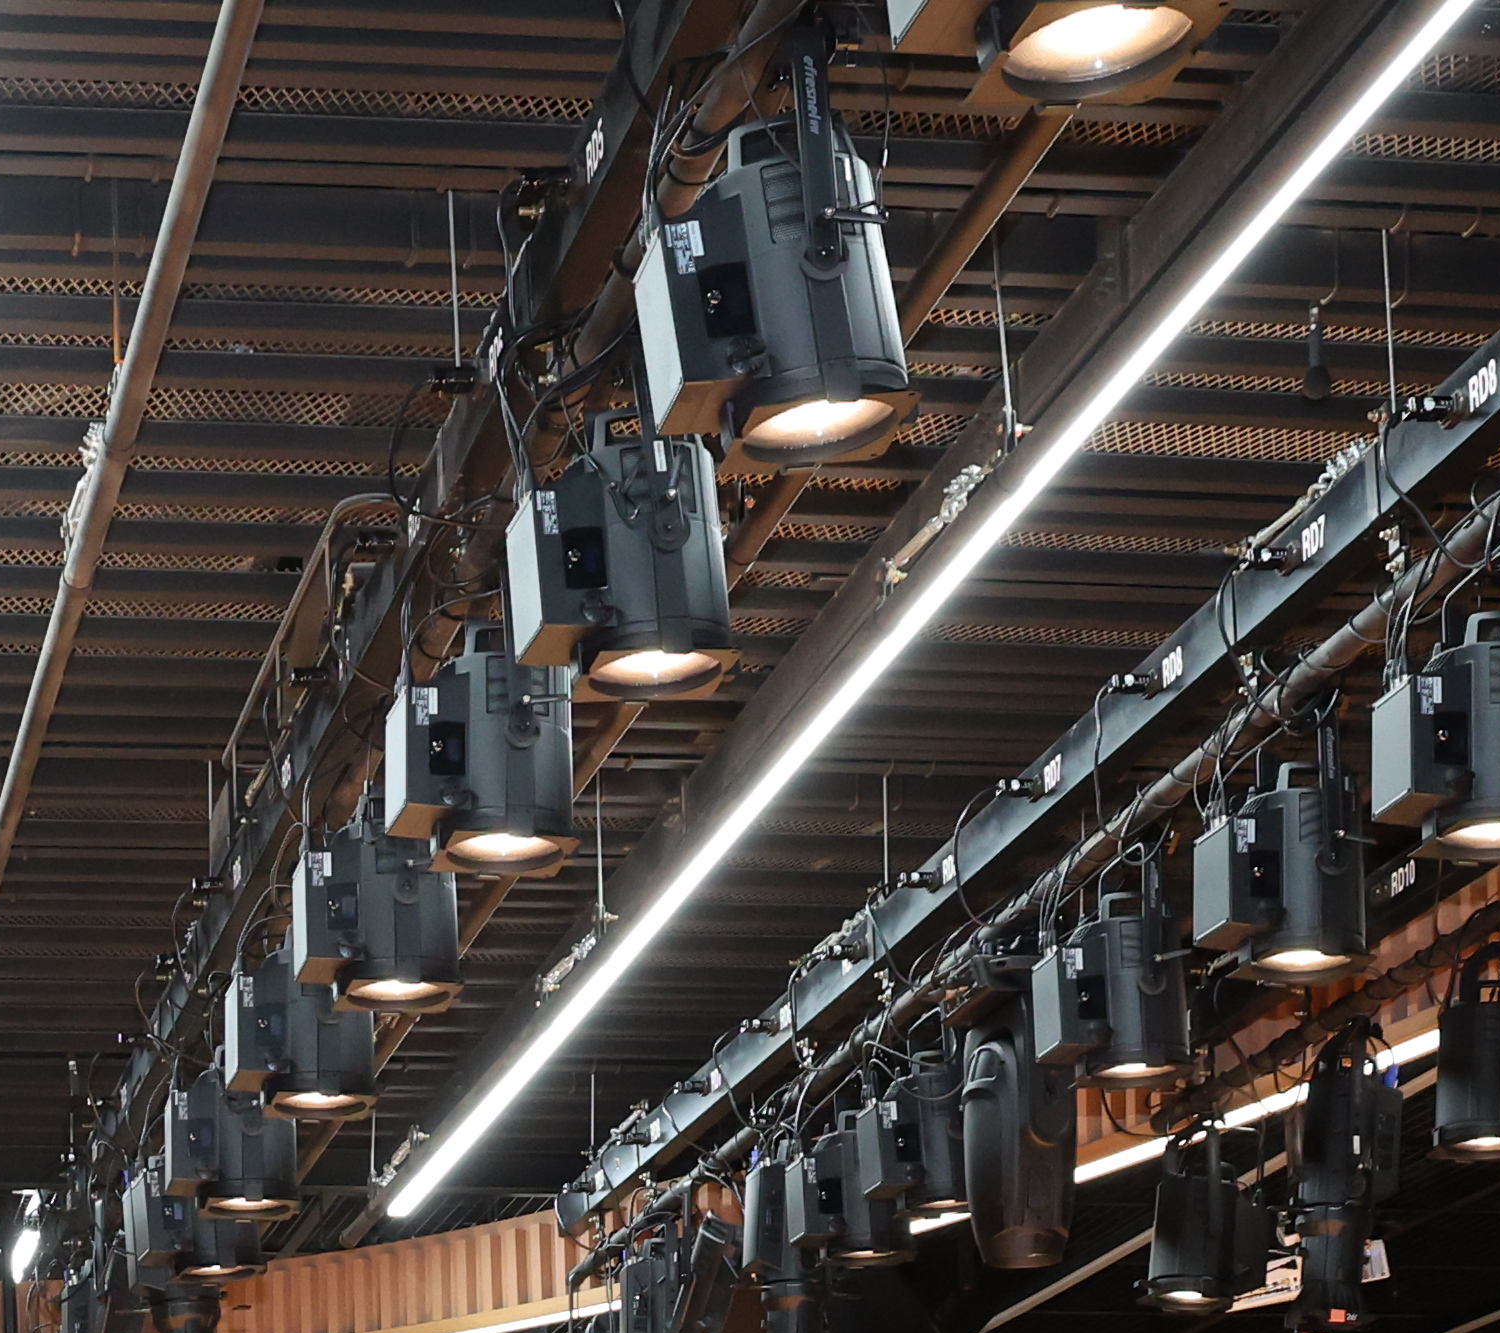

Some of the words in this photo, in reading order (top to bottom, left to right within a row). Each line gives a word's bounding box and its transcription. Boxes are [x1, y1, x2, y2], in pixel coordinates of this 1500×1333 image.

[586, 118, 606, 185] RD5
[1468, 358, 1498, 413] RD8
[1301, 513, 1327, 562] RD7
[1162, 646, 1183, 686] RD8
[1043, 753, 1063, 794] RD7
[1391, 858, 1416, 897] RD10
